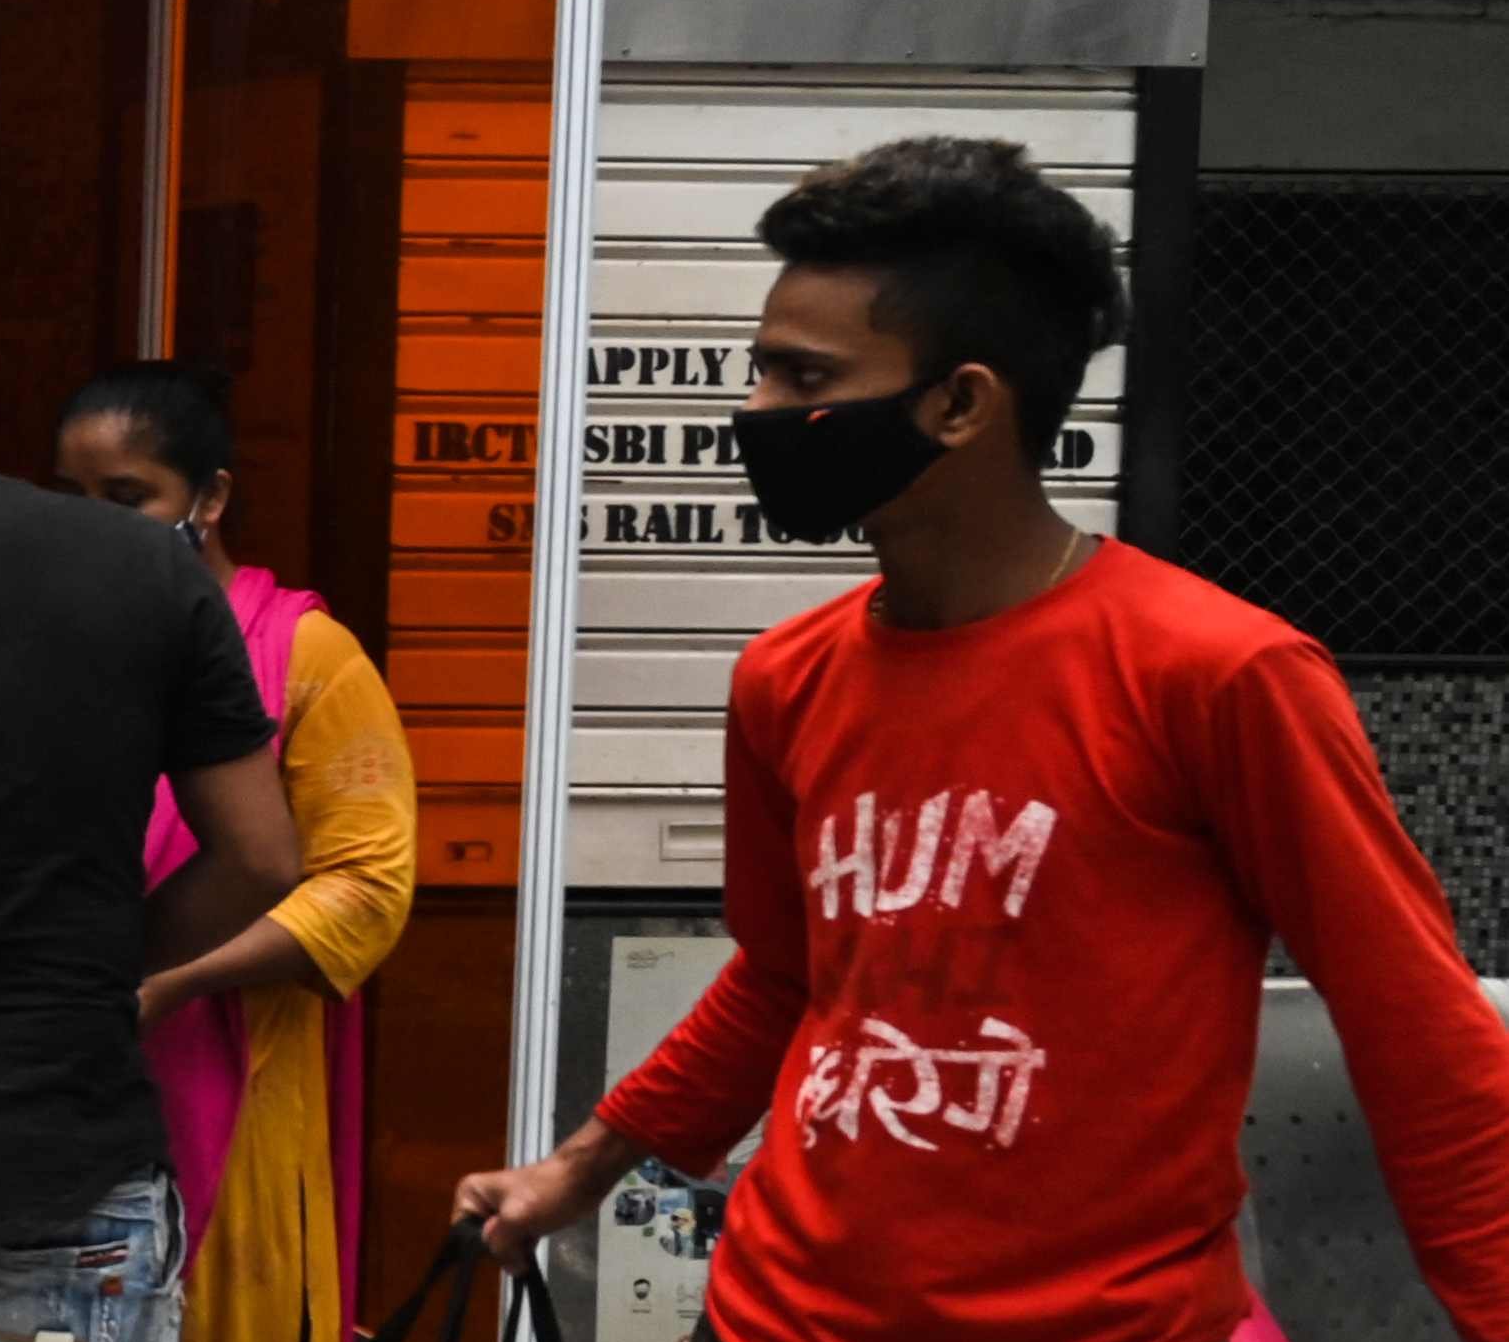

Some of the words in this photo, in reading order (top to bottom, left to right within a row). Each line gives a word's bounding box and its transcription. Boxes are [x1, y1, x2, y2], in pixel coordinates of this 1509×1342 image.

[413, 420, 538, 463] IRCT
[604, 504, 724, 544] RAIL
[809, 789, 1058, 921] HUM
